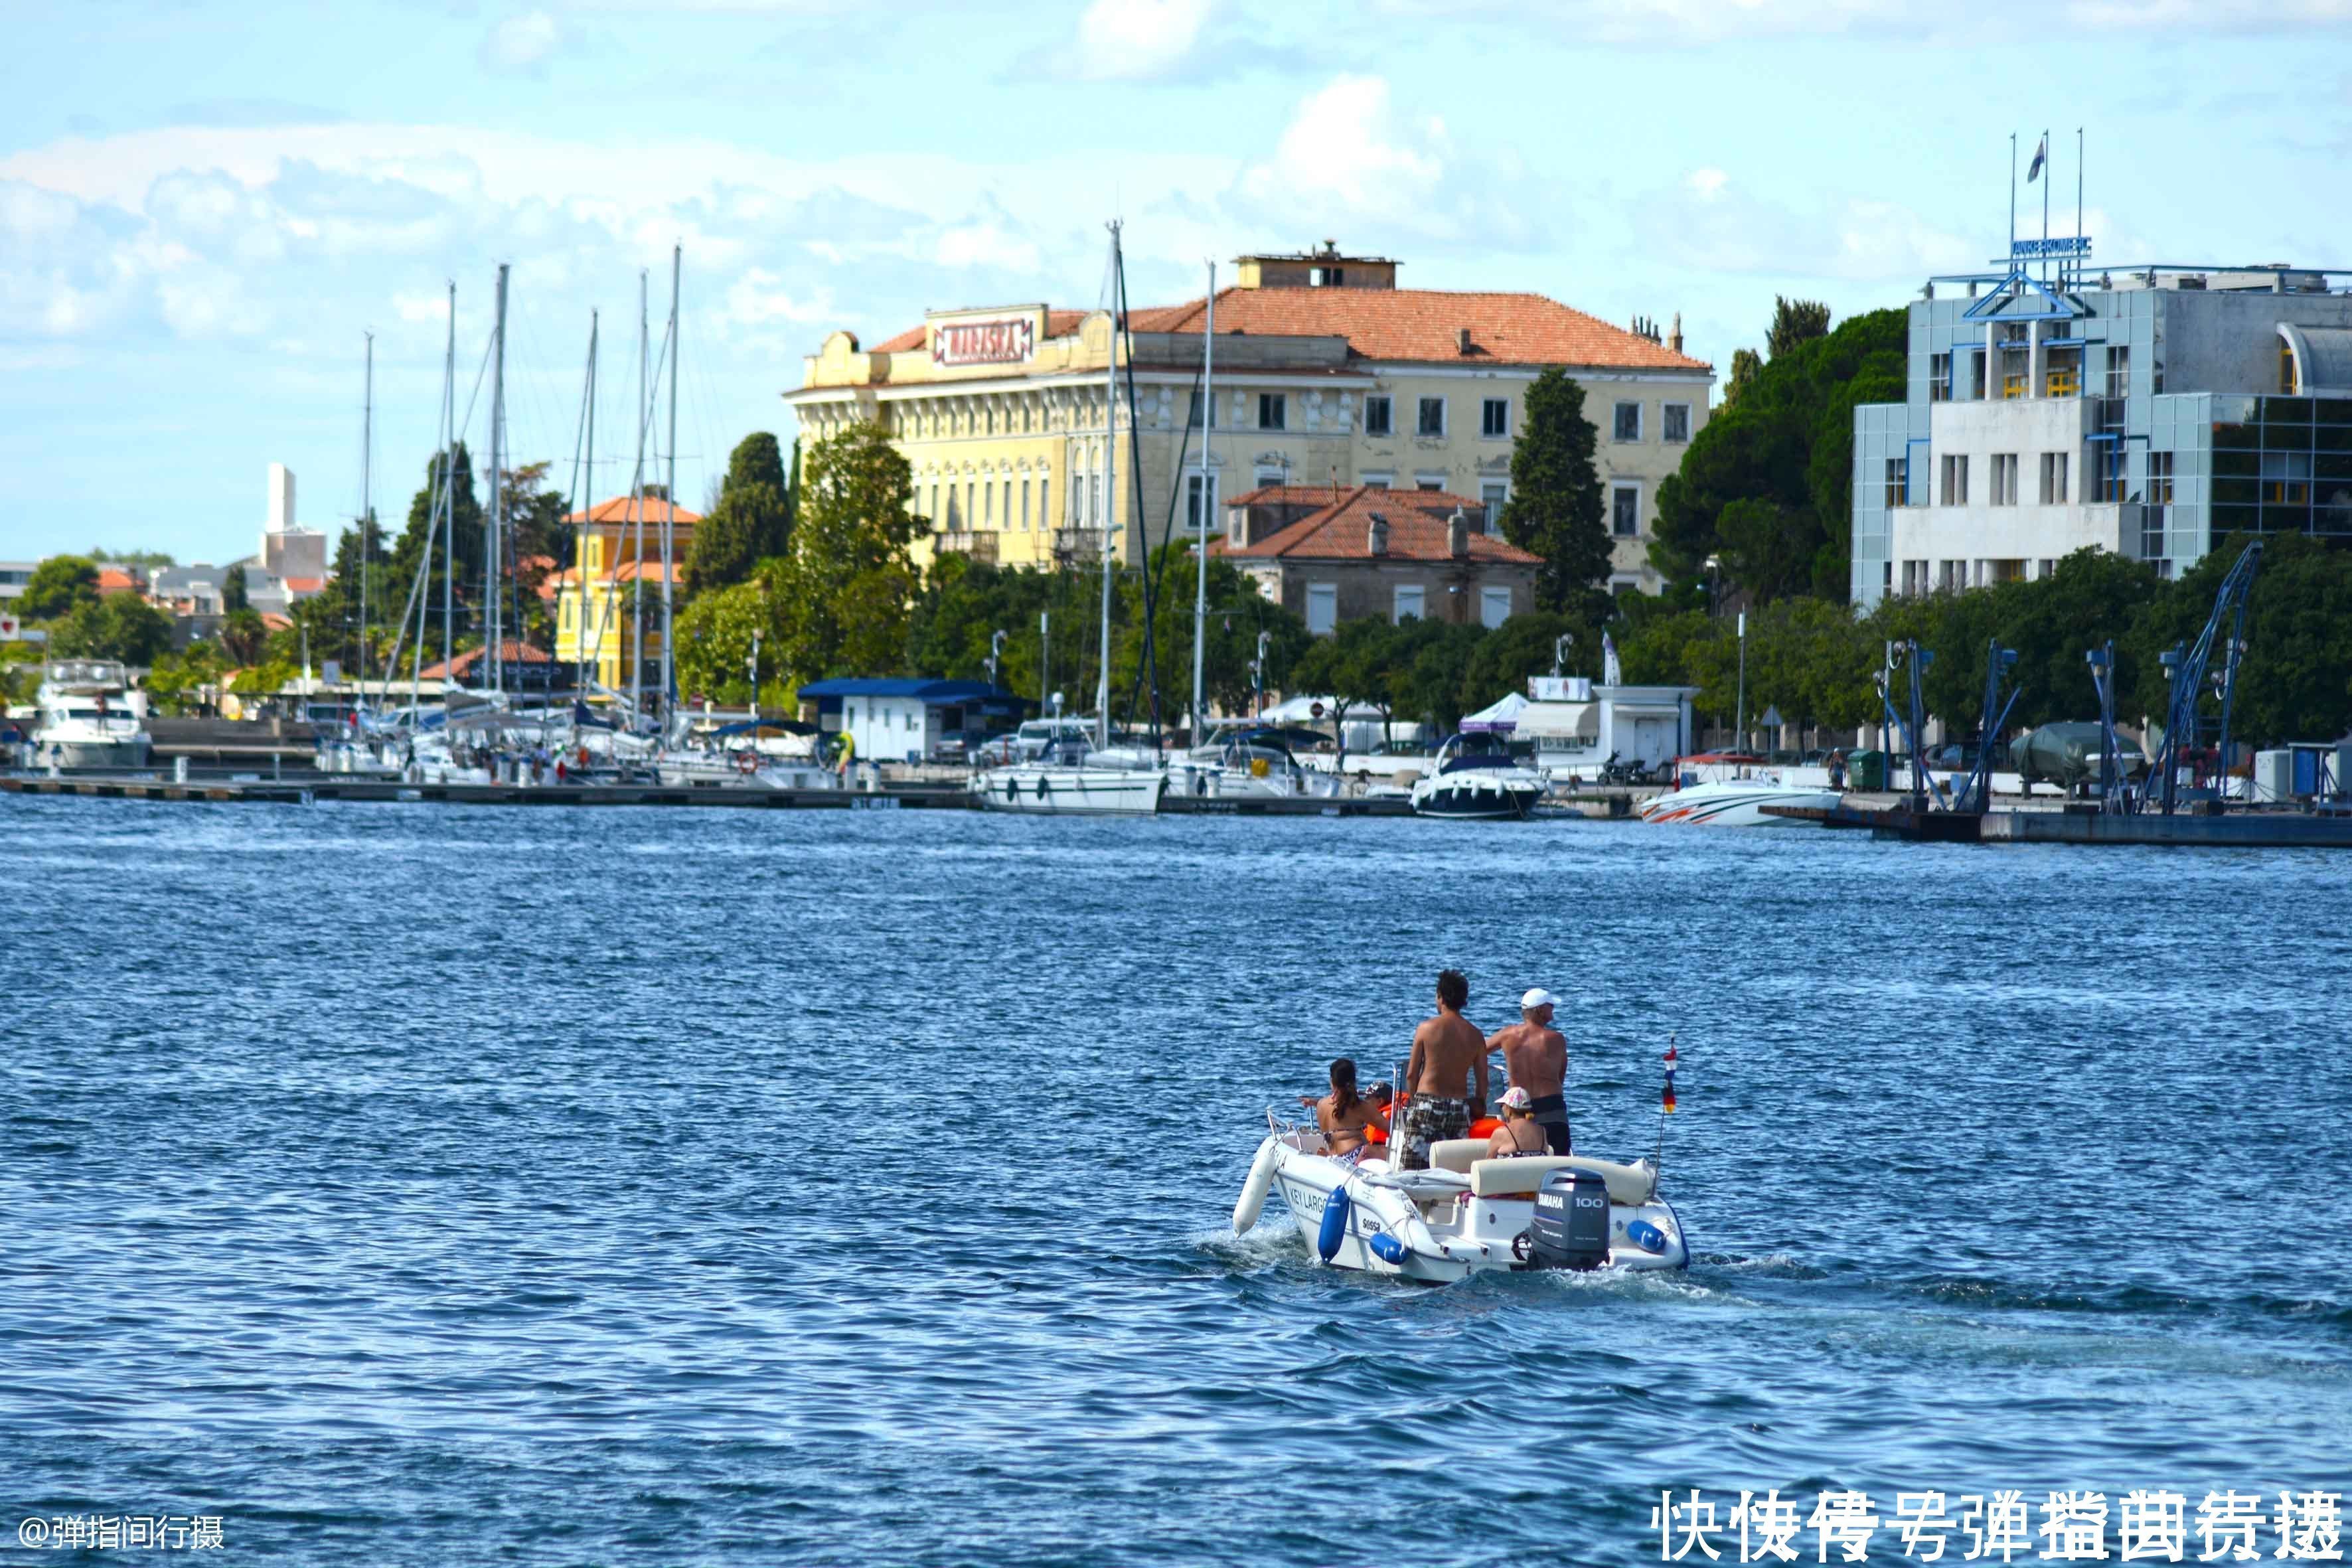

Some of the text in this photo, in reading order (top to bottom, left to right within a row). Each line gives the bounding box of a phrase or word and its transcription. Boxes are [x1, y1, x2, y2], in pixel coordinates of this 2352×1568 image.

[1289, 1187, 1302, 1206] KEY
[1538, 1193, 1563, 1210] YAMAHA
[1575, 1197, 1604, 1209] 100
